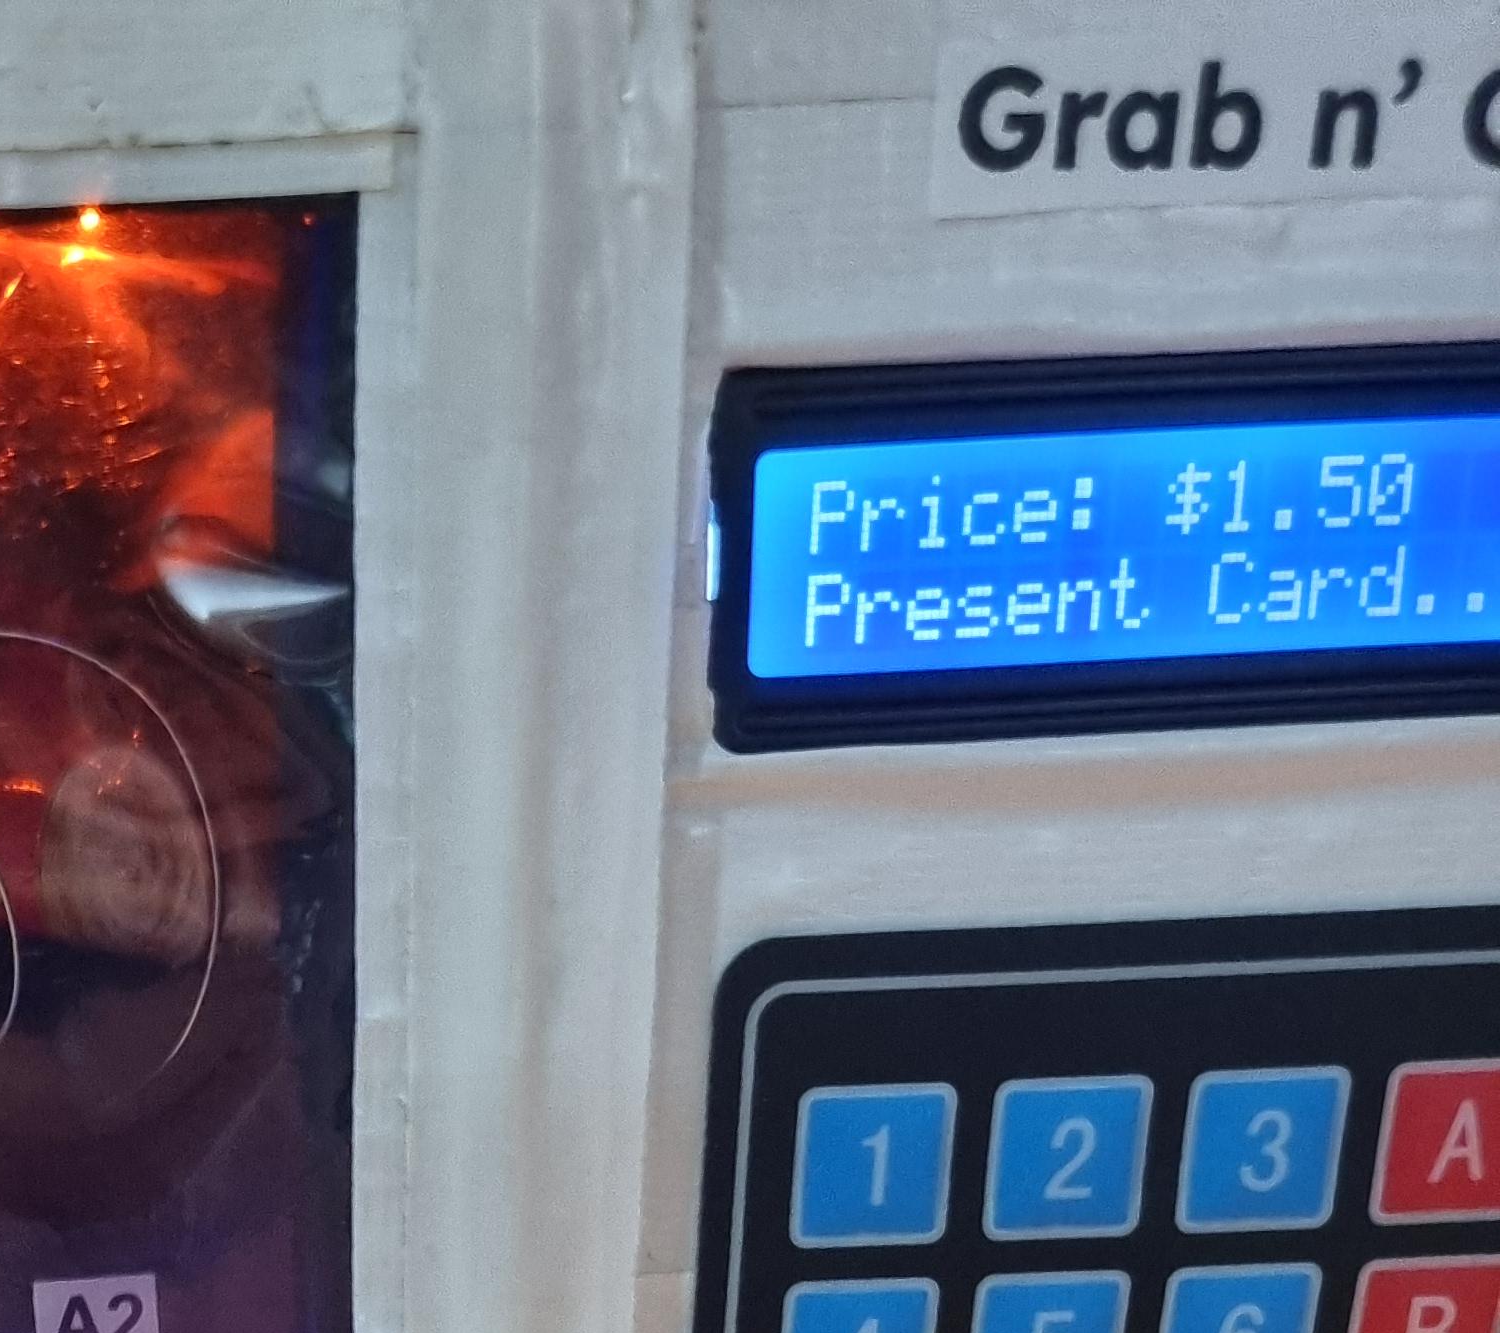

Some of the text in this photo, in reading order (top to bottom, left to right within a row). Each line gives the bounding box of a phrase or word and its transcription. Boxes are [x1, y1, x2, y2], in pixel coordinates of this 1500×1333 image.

[959, 62, 1263, 173] Grab
[808, 452, 1415, 556] Price: $1.50
[804, 557, 1151, 649] Present
[861, 1099, 1488, 1208] 1 2 3 A
